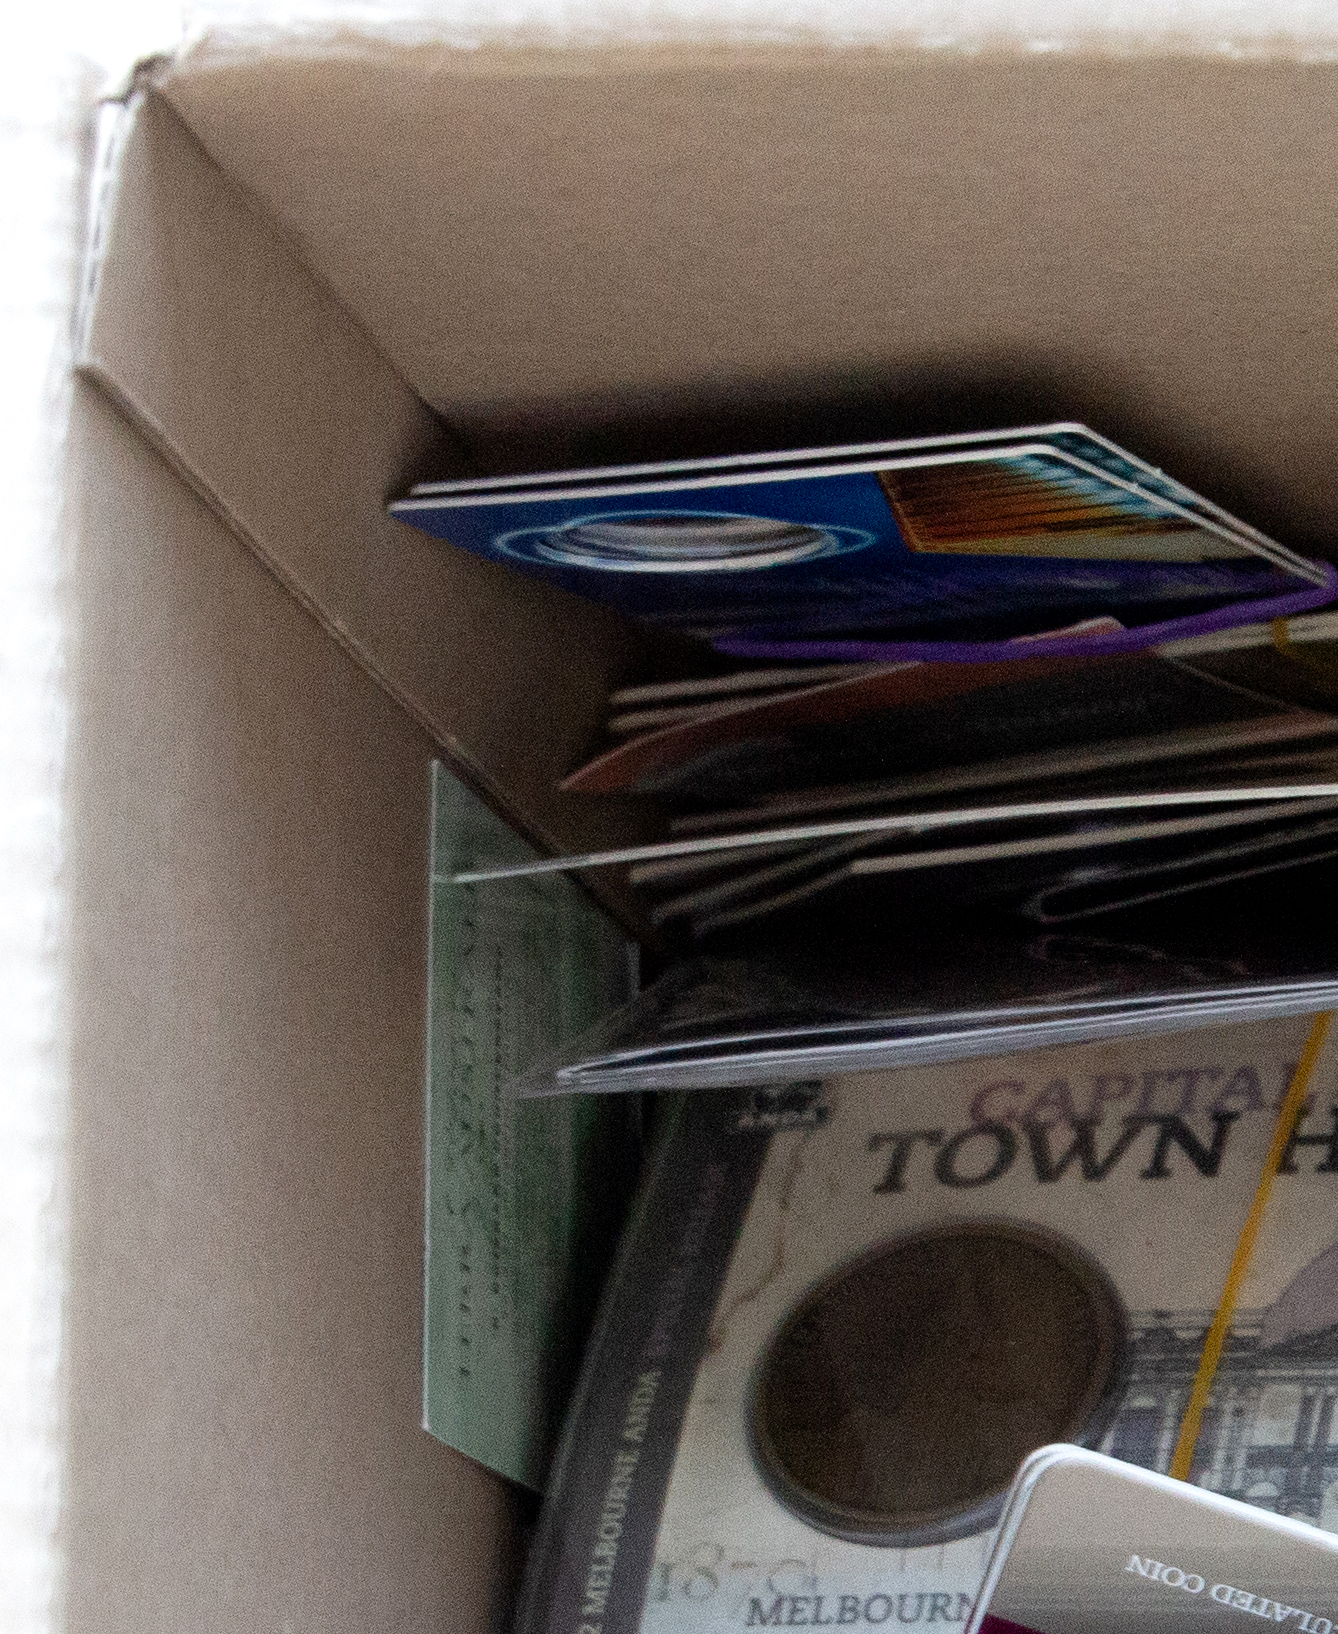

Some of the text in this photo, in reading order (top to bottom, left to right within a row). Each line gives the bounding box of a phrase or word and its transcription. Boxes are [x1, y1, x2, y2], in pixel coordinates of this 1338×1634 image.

[868, 1109, 1241, 1194] TOWN
[582, 1450, 640, 1615] MELBOURNE
[623, 1370, 661, 1442] ANDA
[1124, 1554, 1205, 1595] COIN
